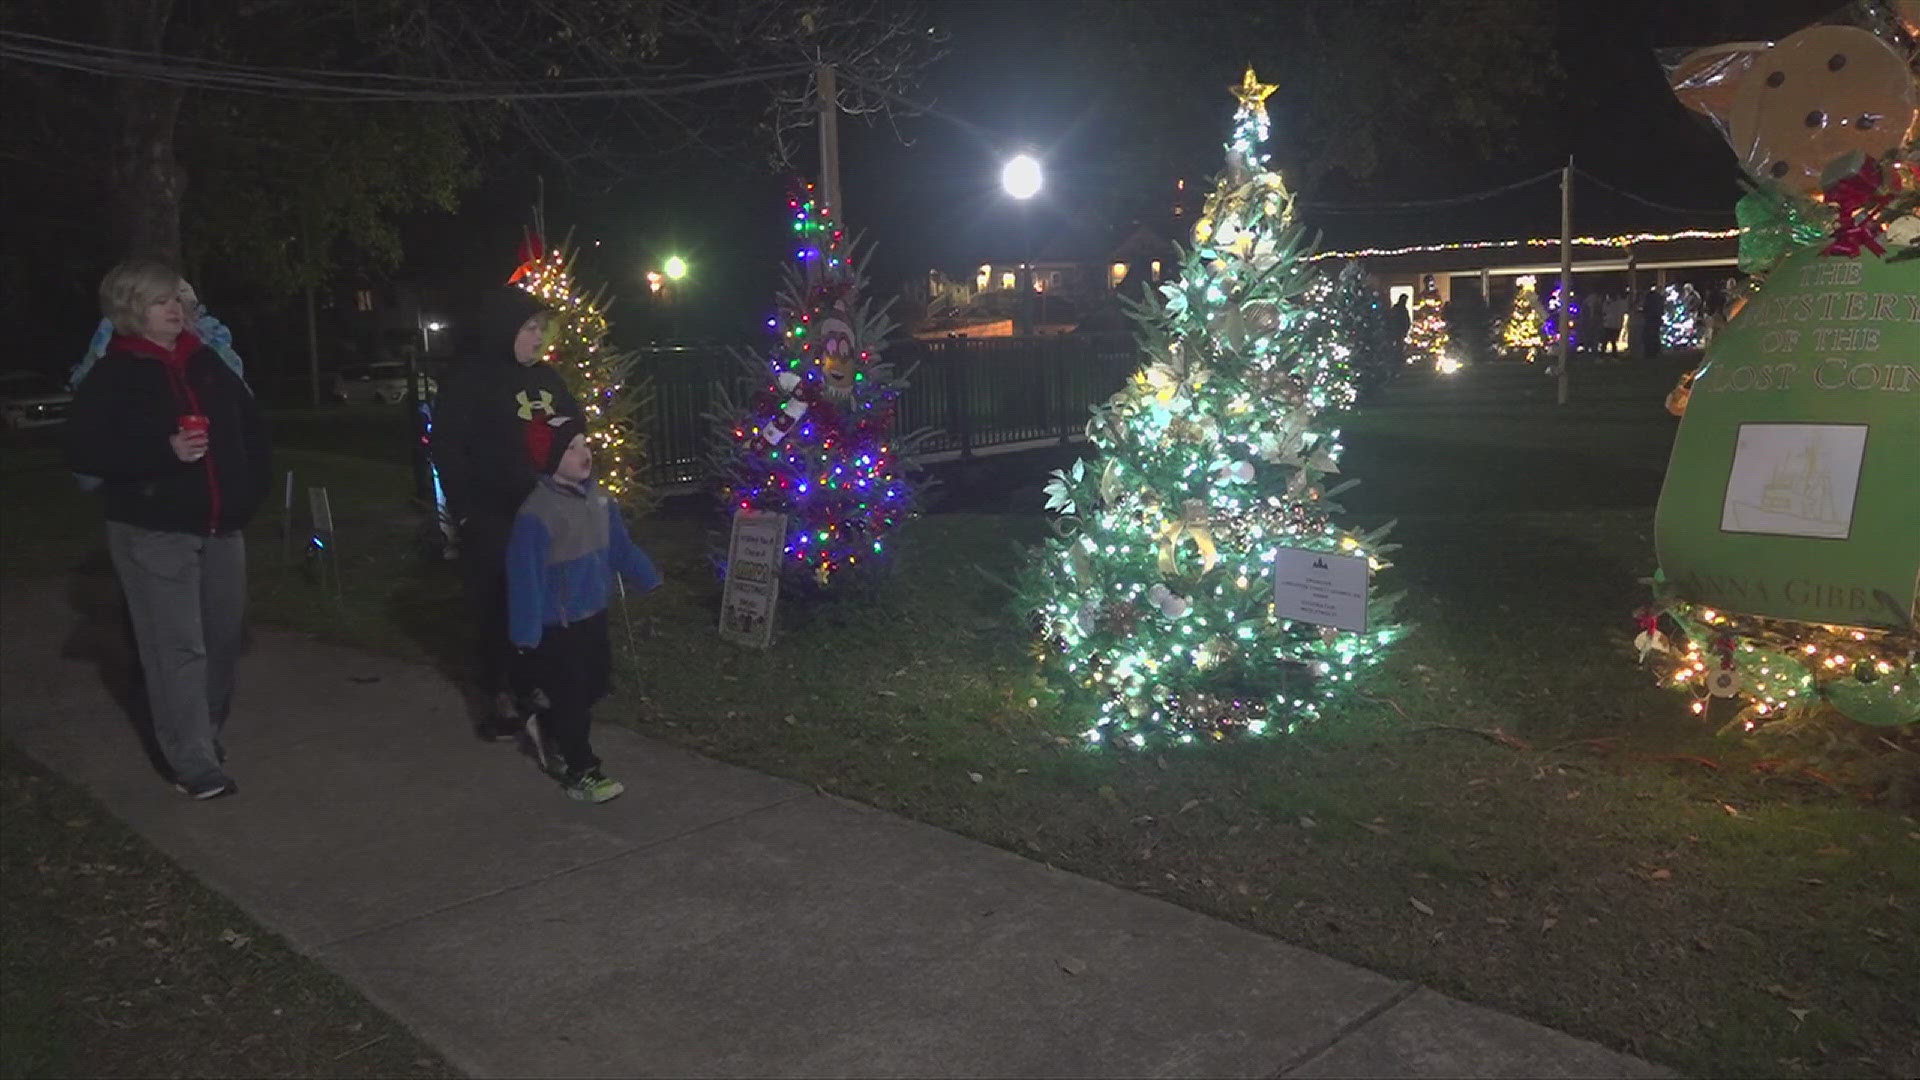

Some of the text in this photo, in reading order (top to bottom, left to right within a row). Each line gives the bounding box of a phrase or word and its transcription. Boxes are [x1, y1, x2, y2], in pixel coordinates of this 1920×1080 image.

[1799, 262, 1863, 287] THE
[1761, 328, 1880, 353] OF THE
[1706, 363, 1801, 392] LOST
